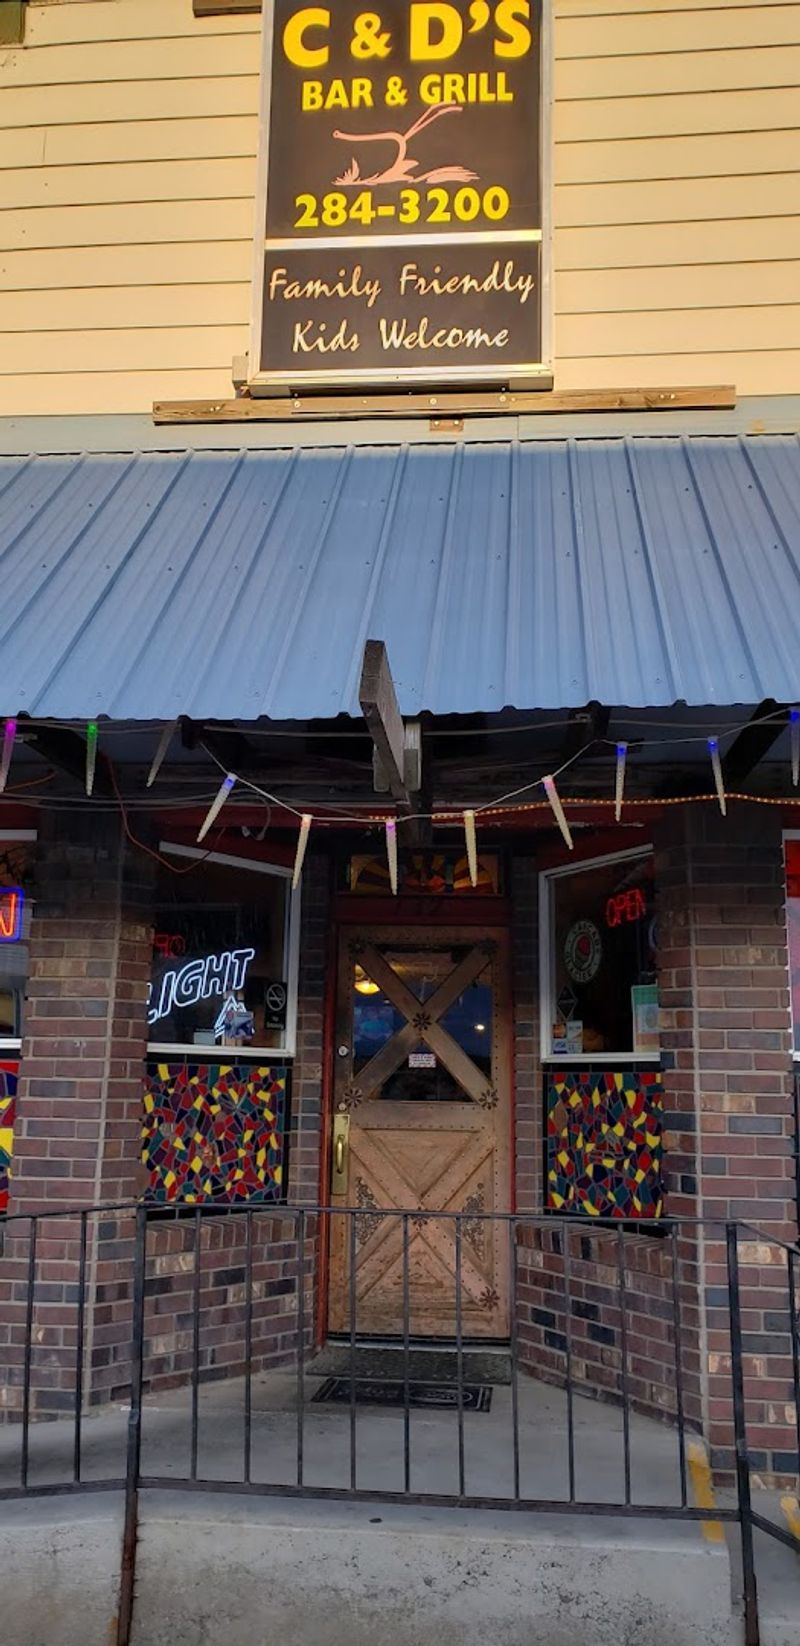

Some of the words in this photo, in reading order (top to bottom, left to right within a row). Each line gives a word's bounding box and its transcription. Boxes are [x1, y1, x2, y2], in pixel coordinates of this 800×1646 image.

[283, 7, 330, 68] C
[351, 12, 392, 59] &
[410, 0, 532, 61] D'S
[302, 77, 373, 111] BAR
[385, 76, 407, 106] &
[420, 72, 513, 104] GRILL
[294, 186, 509, 227] 284-3200
[269, 265, 381, 307] Family
[399, 261, 534, 303] Friendly
[293, 319, 360, 353] Kids
[379, 317, 509, 350] Welcome
